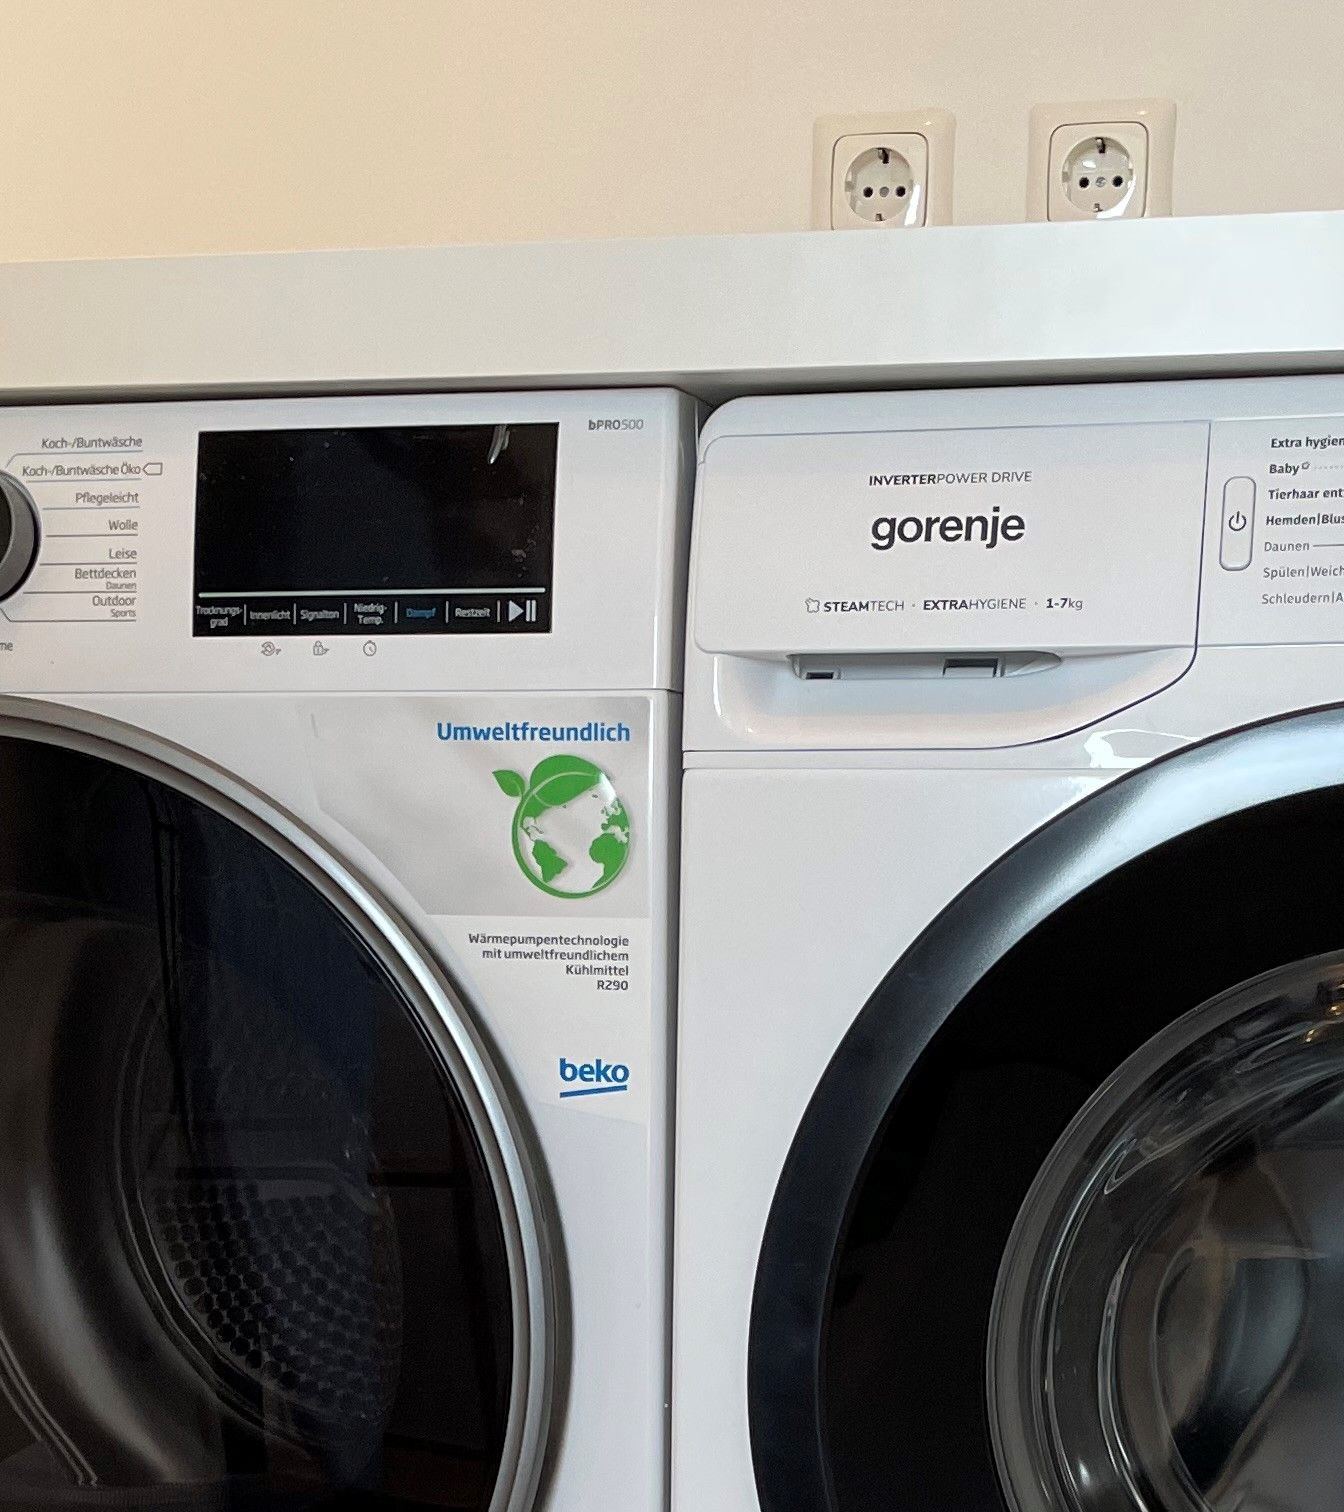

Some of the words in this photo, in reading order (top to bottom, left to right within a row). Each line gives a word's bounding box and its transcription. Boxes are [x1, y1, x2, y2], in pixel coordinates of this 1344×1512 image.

[588, 419, 644, 430] bPRO500
[41, 436, 143, 449] Koch-/Buntwäsche
[1271, 437, 1302, 449] Extra
[22, 463, 119, 477] Koch-/Buntwäsche
[120, 460, 141, 474] Öko
[1269, 463, 1300, 477] Baby
[869, 472, 988, 486] INVERTERPOWER
[991, 470, 1032, 484] DRIVE
[75, 491, 139, 506] Pflegeleicht
[1269, 487, 1320, 500] Tierhaar
[108, 519, 139, 531] Wolle
[871, 505, 1026, 551] gorenje
[1264, 540, 1310, 552] Daunen
[109, 548, 137, 559] Leise
[74, 568, 137, 580] Bettdecken
[92, 595, 137, 607] Outdoor
[823, 599, 905, 613] STEAMTECH
[923, 597, 1027, 612] EXTRAHYGIENE
[1046, 597, 1083, 612] 1-7kg
[437, 722, 630, 742] Umweltfreundlich
[468, 933, 629, 948] Wärmepumpentechnologie
[482, 949, 502, 959] mit
[504, 949, 629, 961] umweltfreundlichem
[565, 964, 629, 976] Kühlmittel
[597, 979, 629, 991] R290
[559, 1058, 629, 1082] beko
